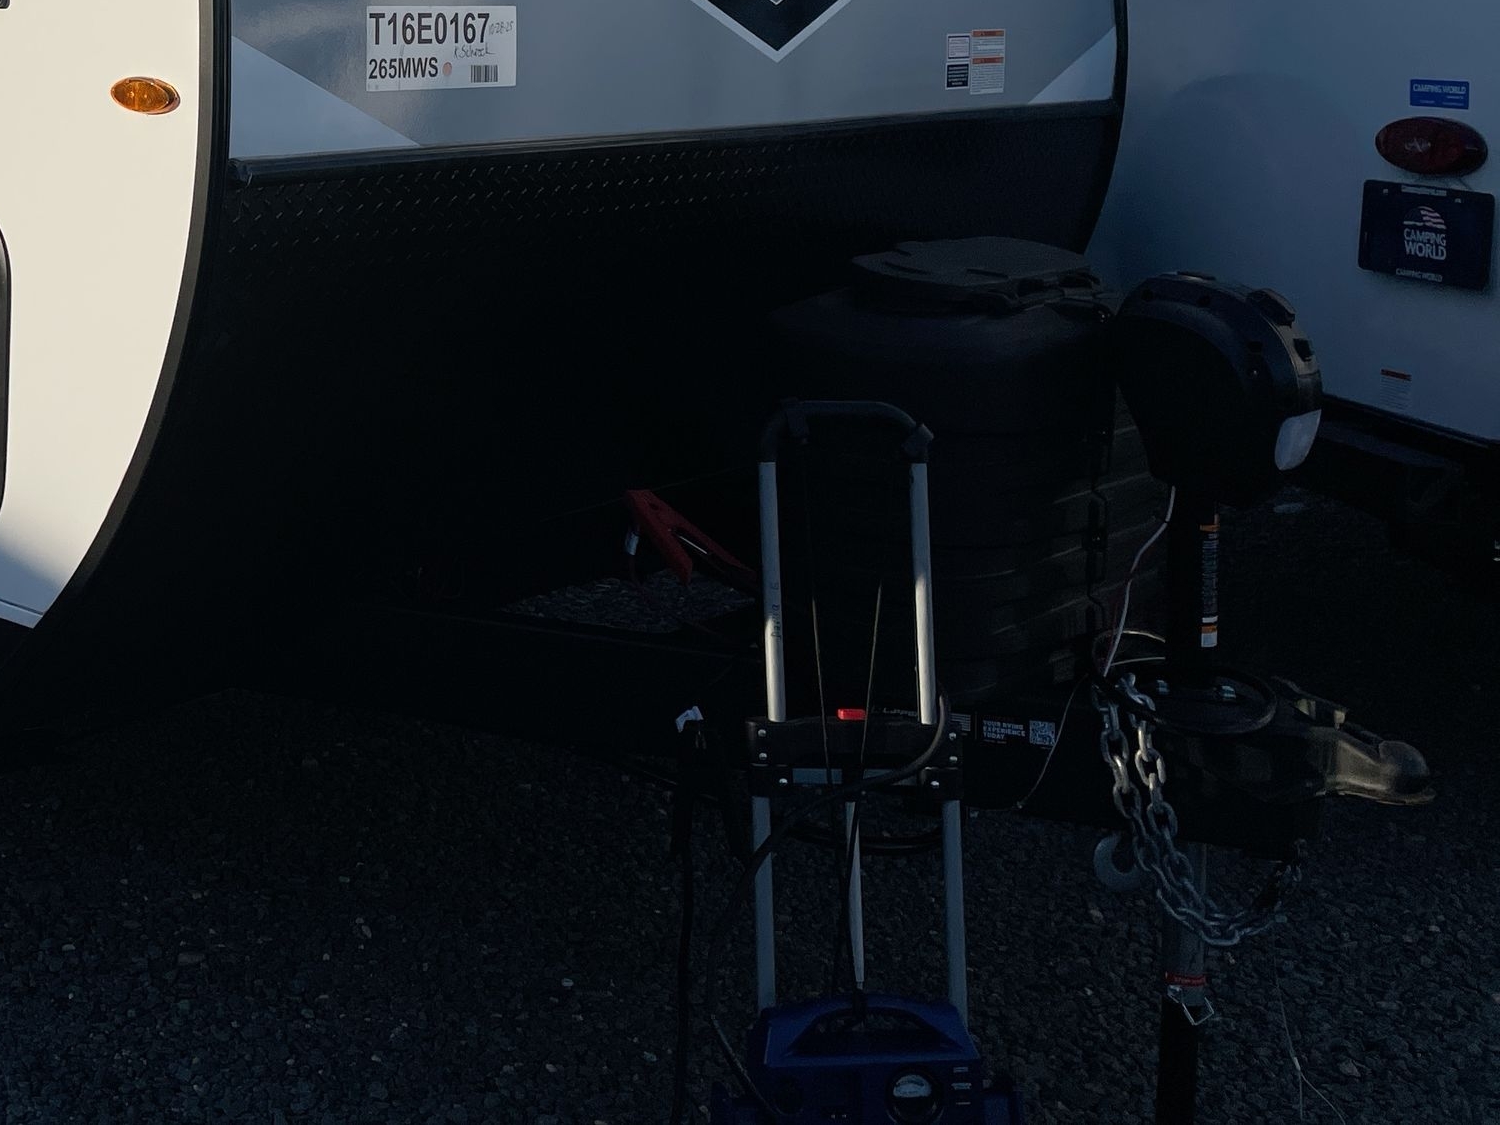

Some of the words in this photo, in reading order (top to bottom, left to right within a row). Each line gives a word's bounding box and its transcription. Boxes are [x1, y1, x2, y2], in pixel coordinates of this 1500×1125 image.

[369, 12, 490, 45] T16E0167
[369, 57, 438, 79] 265MWS
[1404, 228, 1447, 246] CAMPING
[1404, 240, 1447, 261] WORLD
